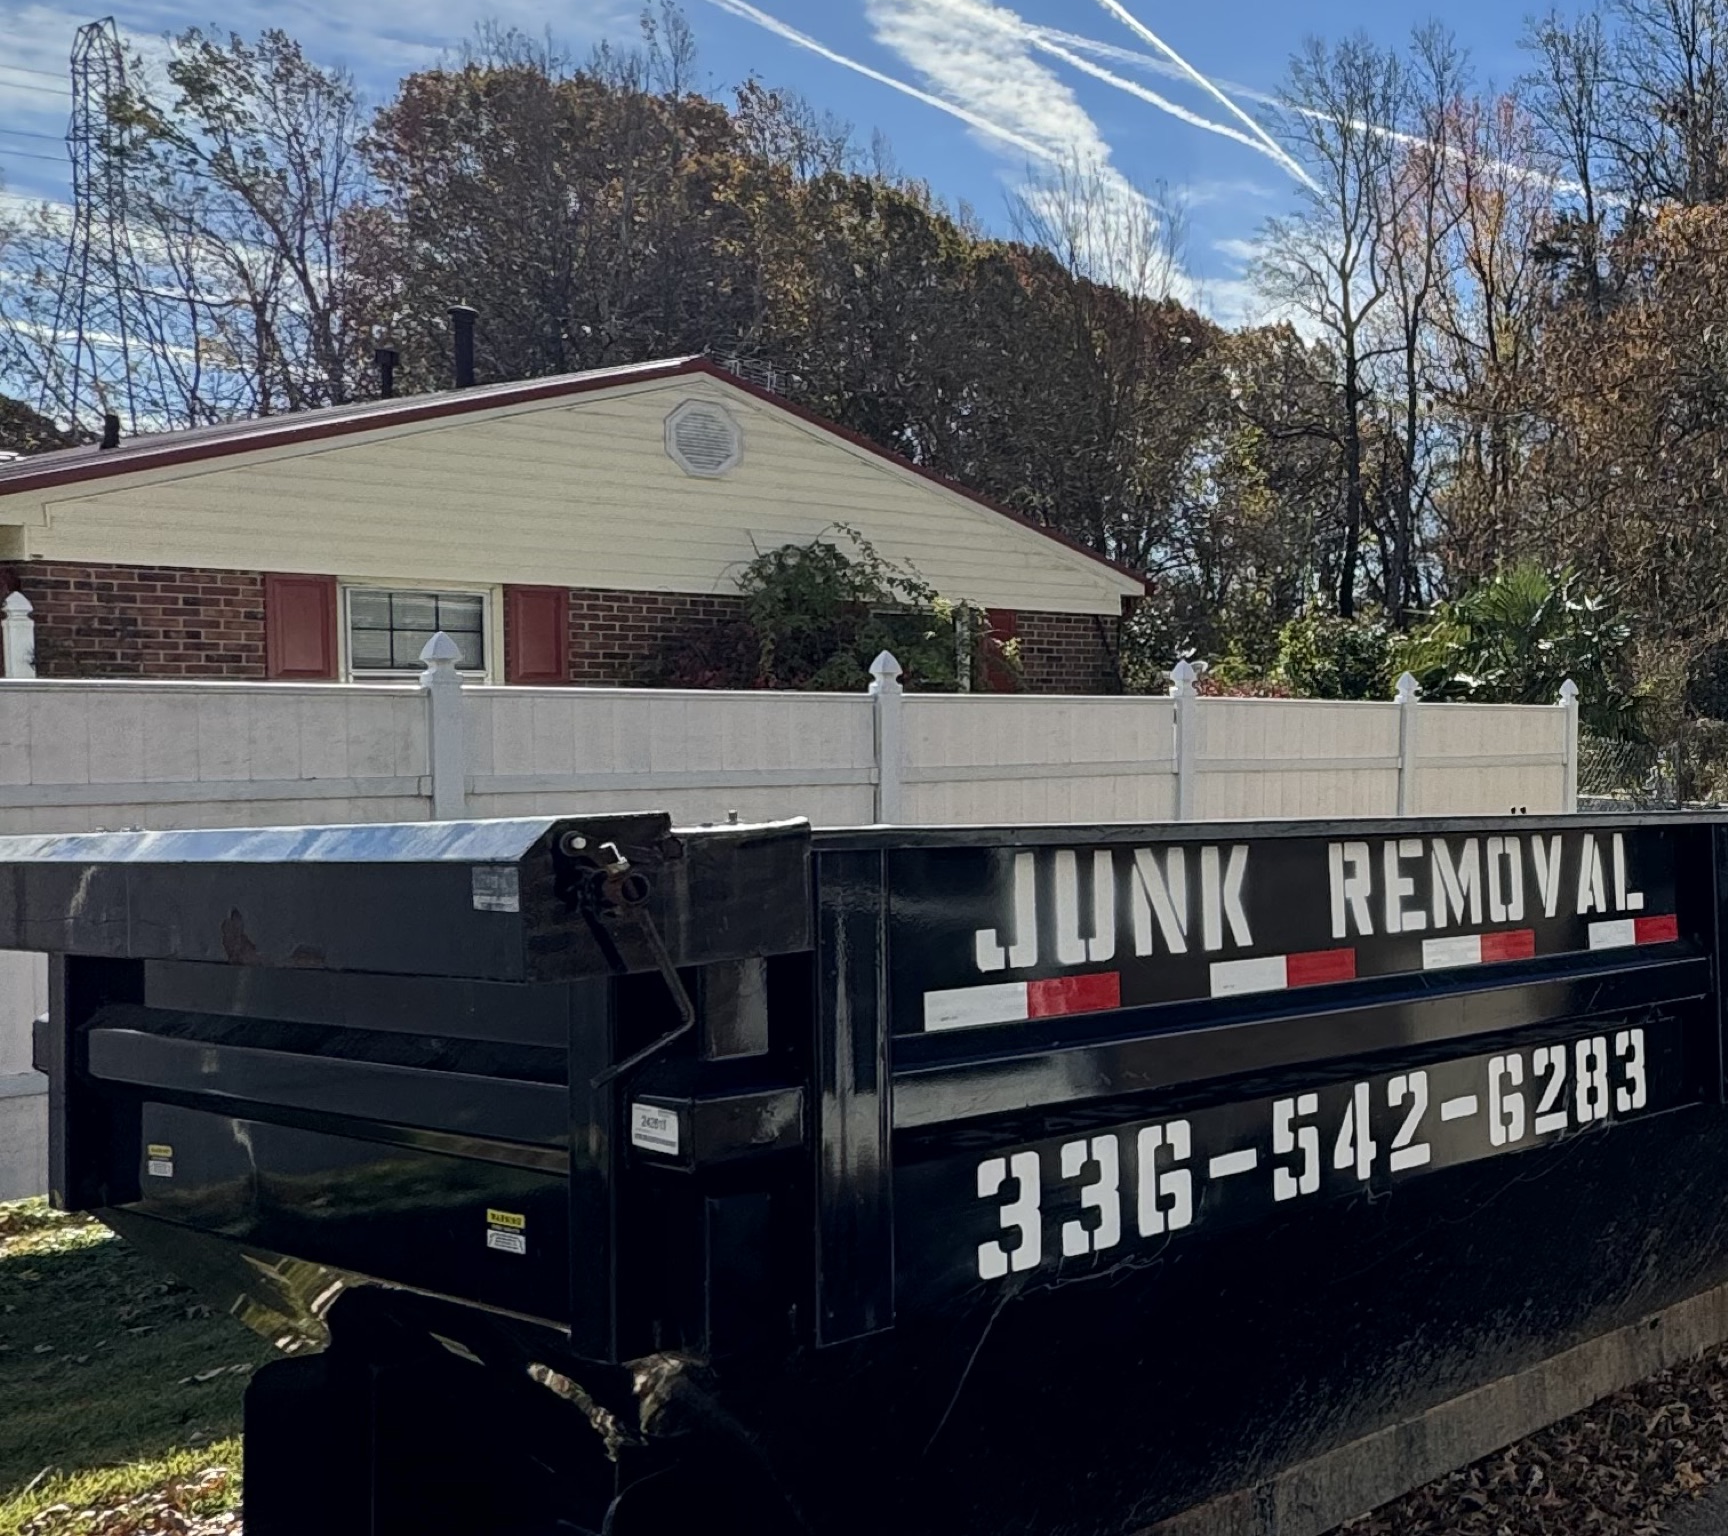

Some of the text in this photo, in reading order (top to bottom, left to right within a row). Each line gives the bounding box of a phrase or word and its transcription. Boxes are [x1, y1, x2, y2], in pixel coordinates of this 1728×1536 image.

[975, 832, 1646, 973] JUNK REMOVAL
[976, 1027, 1649, 1280] 336-542-6283
